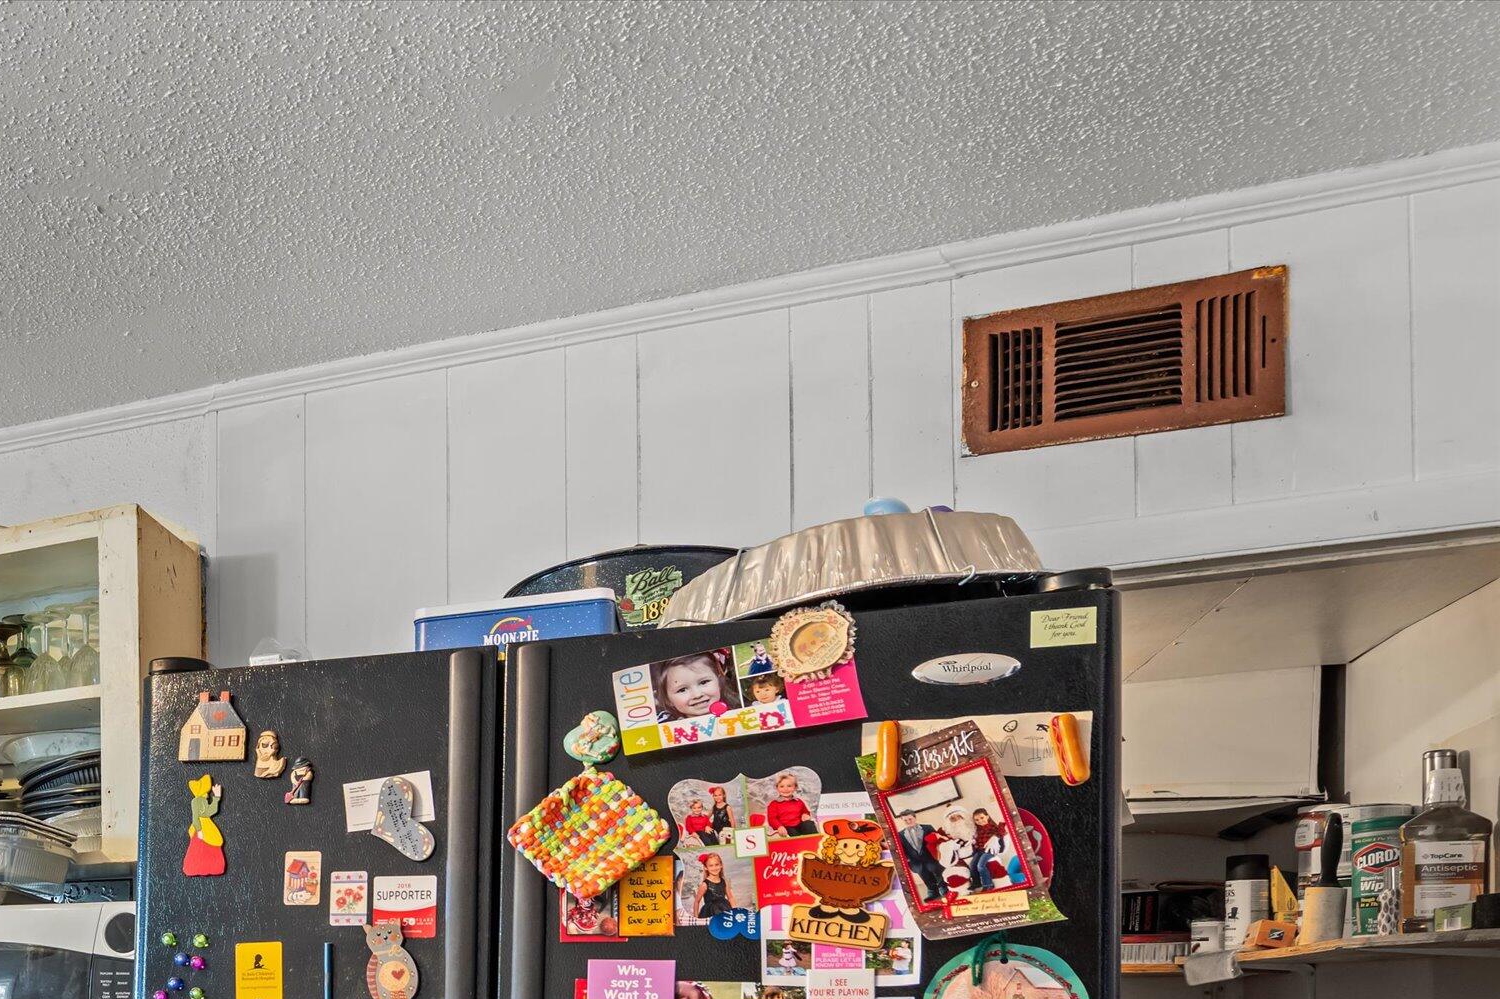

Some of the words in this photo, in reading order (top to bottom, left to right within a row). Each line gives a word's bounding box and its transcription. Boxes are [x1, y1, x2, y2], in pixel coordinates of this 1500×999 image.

[631, 565, 677, 595] Ball
[1041, 614, 1059, 624] Dear
[1050, 622, 1068, 631] thank
[1049, 631, 1062, 641] for
[942, 661, 992, 675] Whirlpool
[636, 736, 648, 747] 4
[745, 834, 757, 850] S
[1357, 847, 1401, 869] CLOROX
[1421, 864, 1479, 874] Antiseptic
[811, 869, 881, 887] MARCIA'S
[1360, 880, 1385, 892] Wip
[377, 890, 433, 901] SUPPORTER
[632, 890, 657, 901] today
[627, 903, 648, 912] that
[628, 916, 645, 925] love
[747, 910, 756, 934] NNELS
[791, 917, 883, 943] KITCHEN
[616, 964, 647, 976] Who
[610, 979, 640, 991] says
[644, 977, 653, 988] I
[835, 978, 848, 987] SEE
[809, 988, 836, 997] YOU'RE
[838, 988, 870, 997] PLAYING
